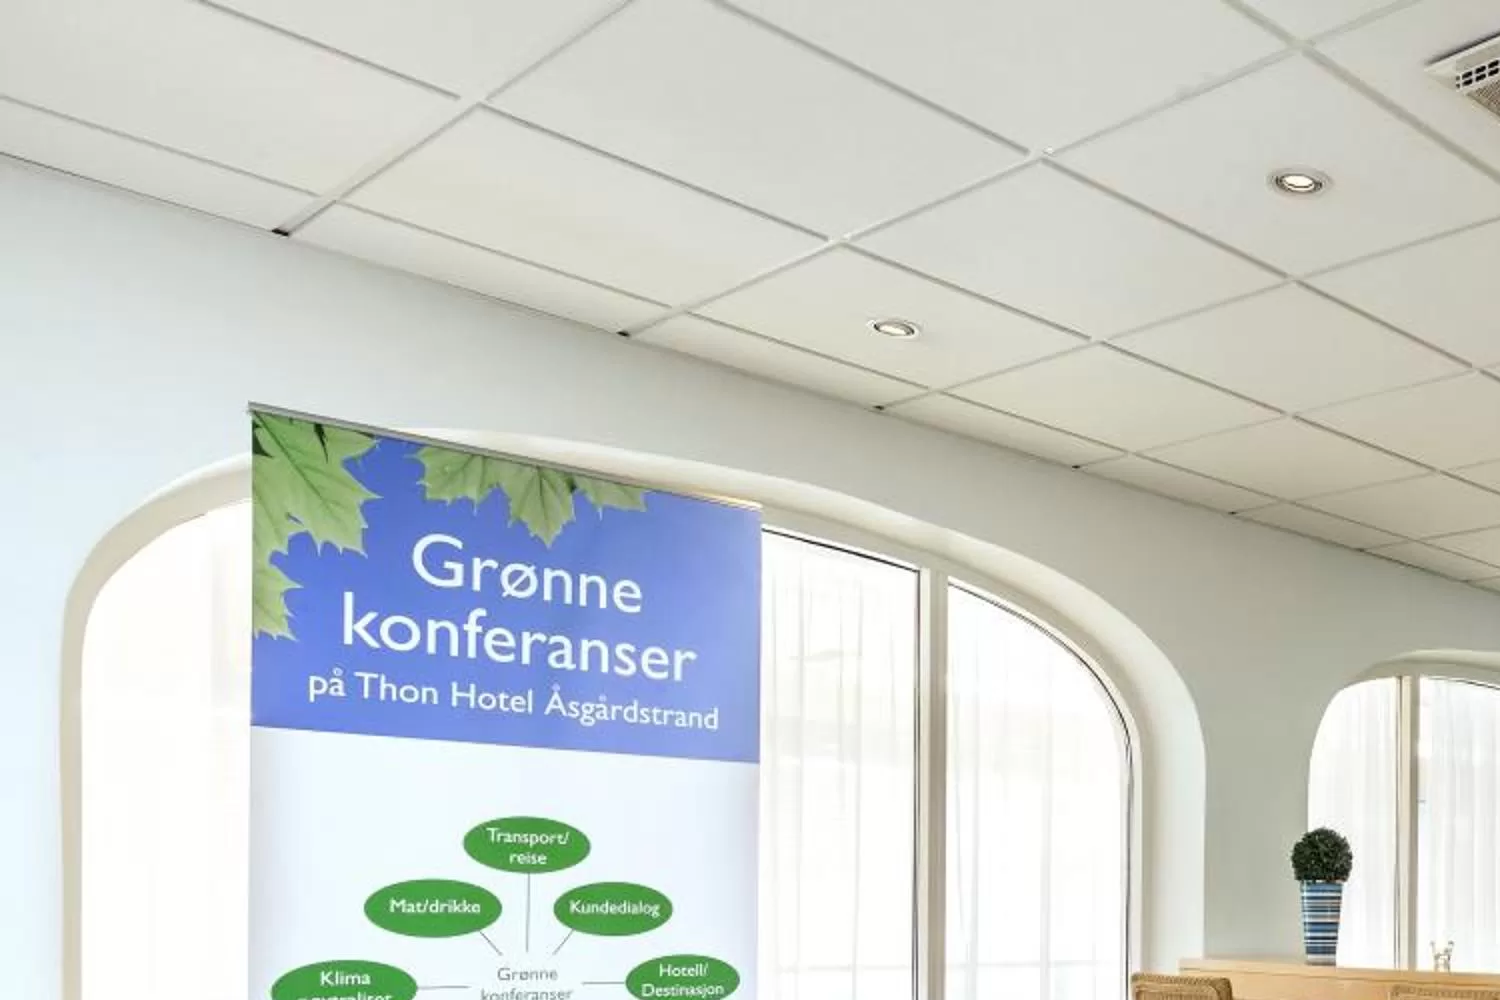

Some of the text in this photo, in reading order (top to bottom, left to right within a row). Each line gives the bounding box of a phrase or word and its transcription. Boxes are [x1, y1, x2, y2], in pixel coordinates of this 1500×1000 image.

[412, 533, 643, 614] Grønne
[343, 590, 697, 682] konferanser
[308, 668, 720, 731] på Thon Hotel Åsgårdstrand
[487, 827, 570, 847] Transport/
[509, 850, 548, 866] reise
[389, 897, 482, 917] Mat/drikke
[568, 899, 661, 918] Kundedialog
[320, 970, 372, 988] Klima
[497, 967, 558, 984] Grønne
[658, 962, 710, 979] Hotell/
[641, 980, 725, 1000] Destinasjon
